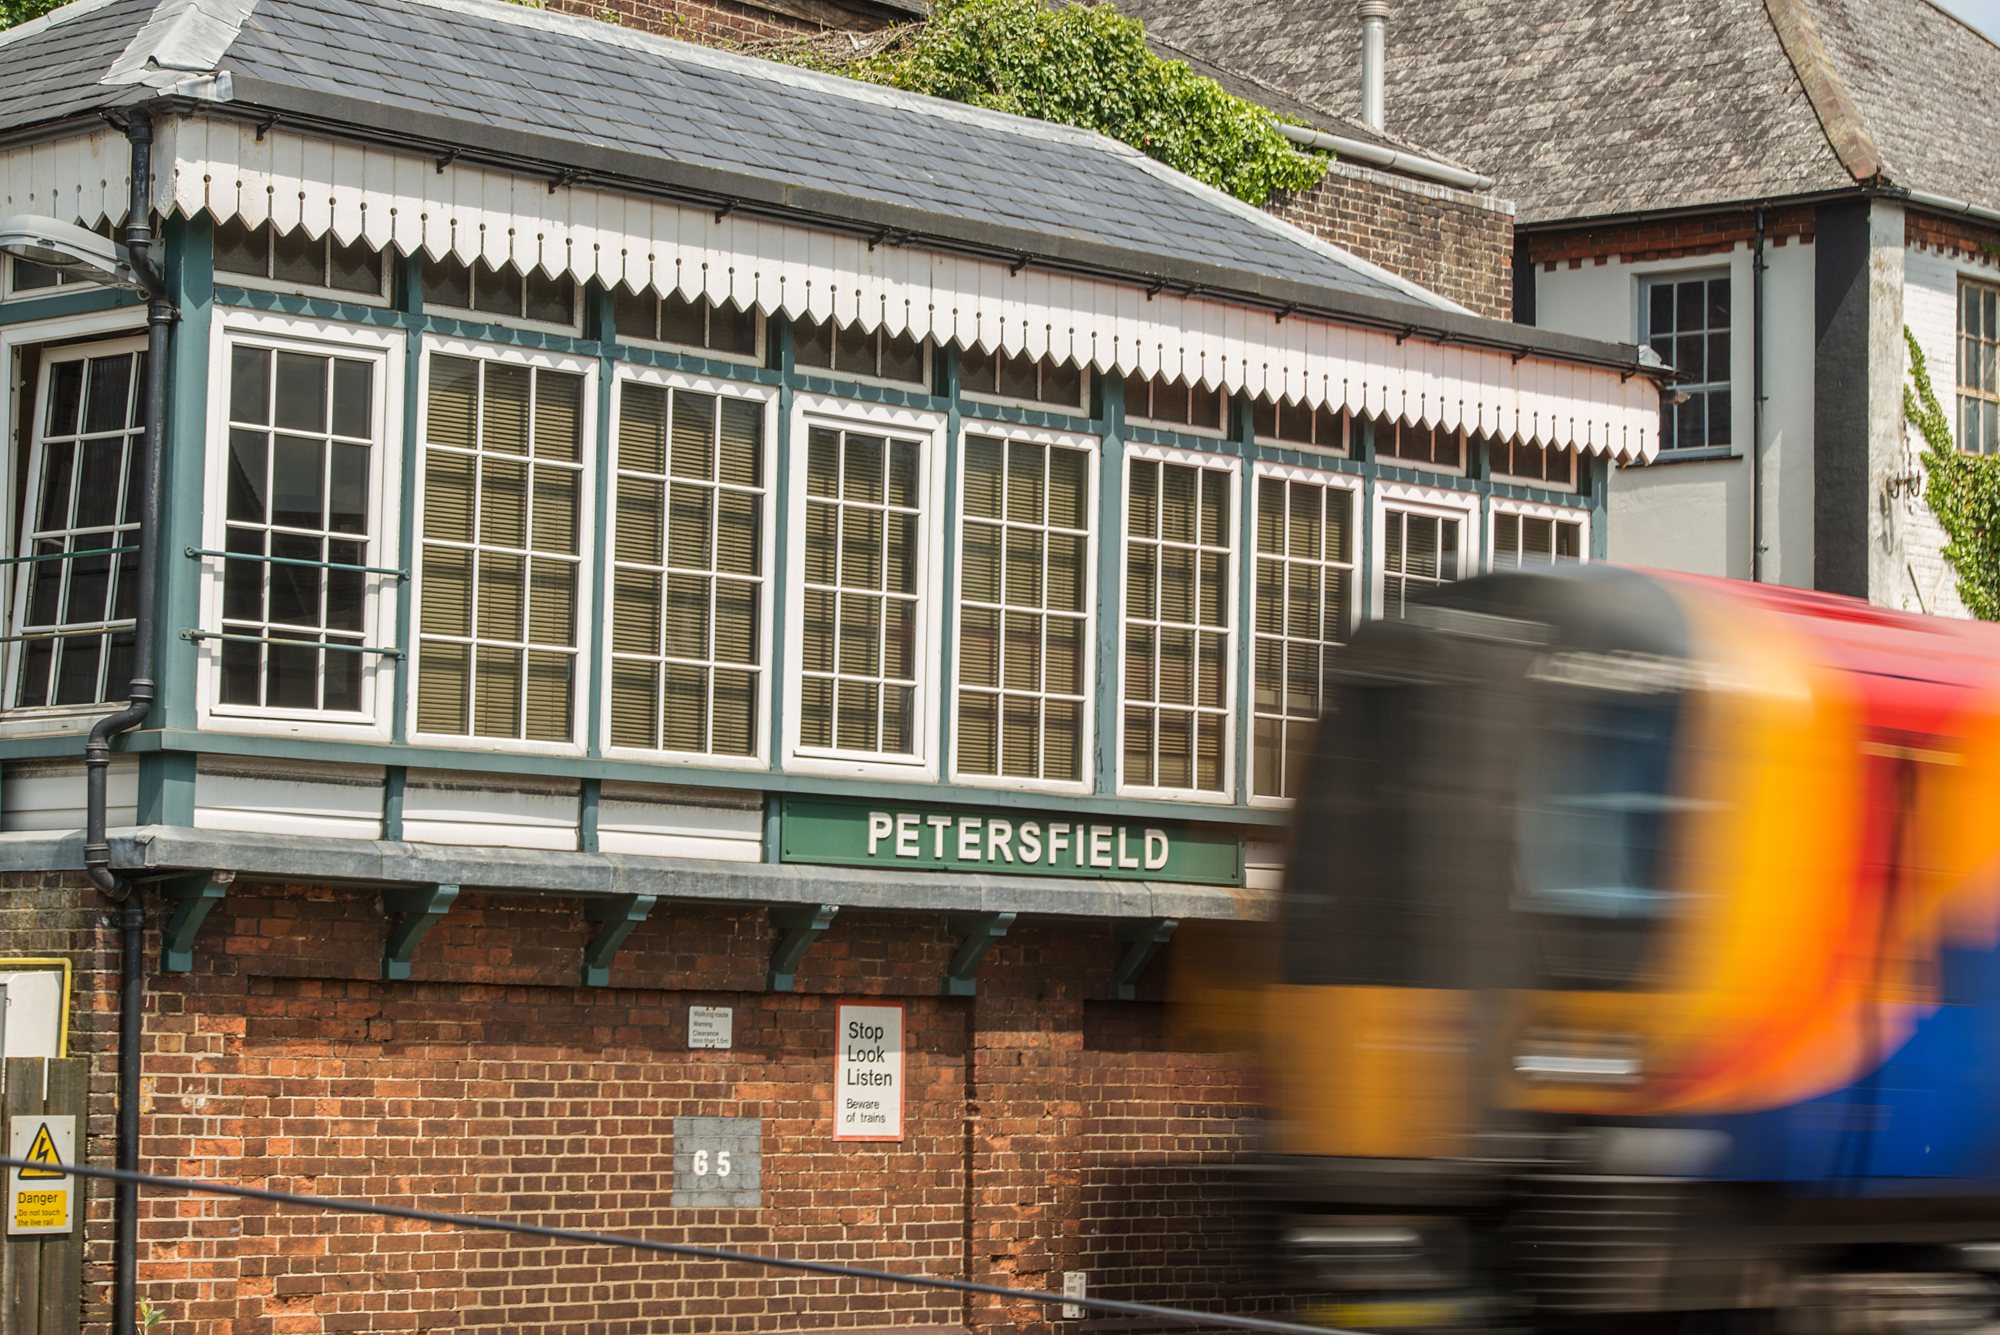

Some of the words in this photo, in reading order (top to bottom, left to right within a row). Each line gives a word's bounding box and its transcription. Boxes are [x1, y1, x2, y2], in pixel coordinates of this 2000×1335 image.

[867, 811, 1170, 870] PETERSFIELD
[848, 1021, 884, 1043] Stop
[847, 1045, 885, 1063] Look
[847, 1068, 893, 1086] Listen
[846, 1098, 880, 1110] Beware
[846, 1112, 856, 1123] of
[860, 1112, 886, 1123] trains
[18, 1192, 58, 1205] Danger
[29, 1209, 41, 1217] not
[41, 1209, 61, 1217] touch
[17, 1219, 29, 1227] the
